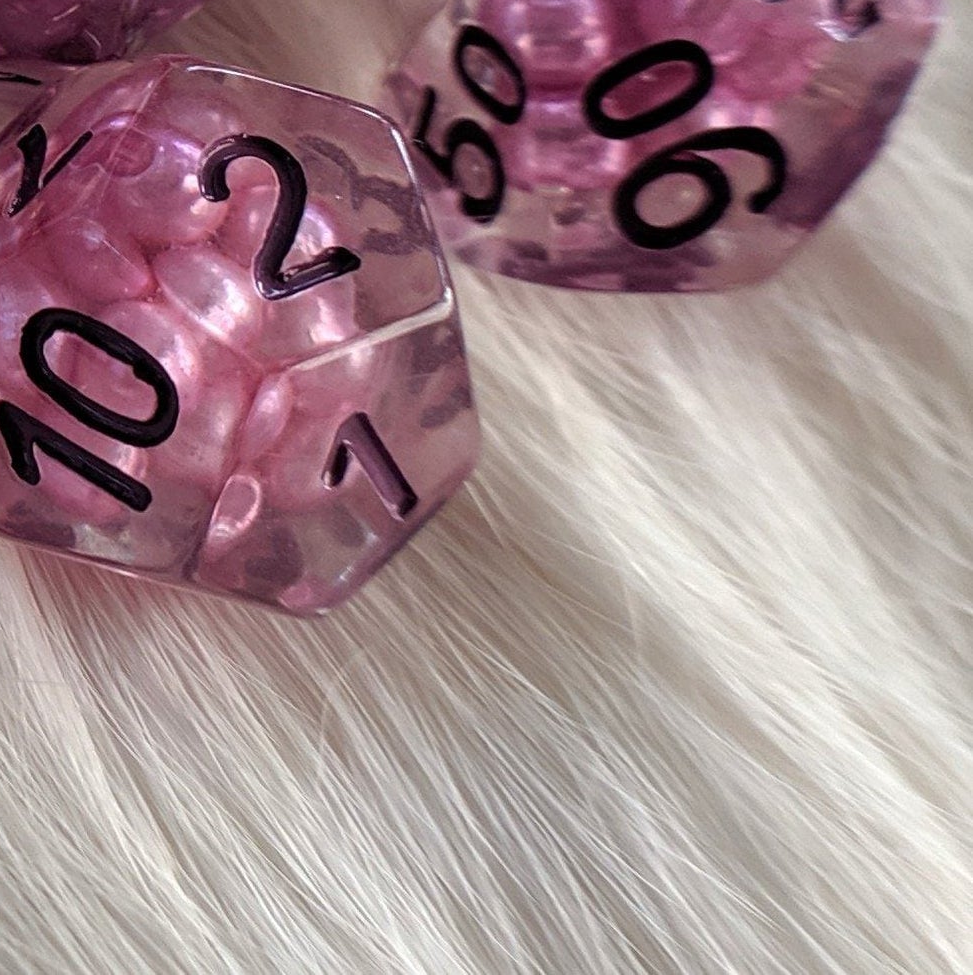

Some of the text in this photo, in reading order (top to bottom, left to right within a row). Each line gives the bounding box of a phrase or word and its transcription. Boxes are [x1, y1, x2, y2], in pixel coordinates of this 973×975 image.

[196, 132, 362, 301] 2
[411, 24, 527, 224] 50
[581, 38, 788, 251] 90
